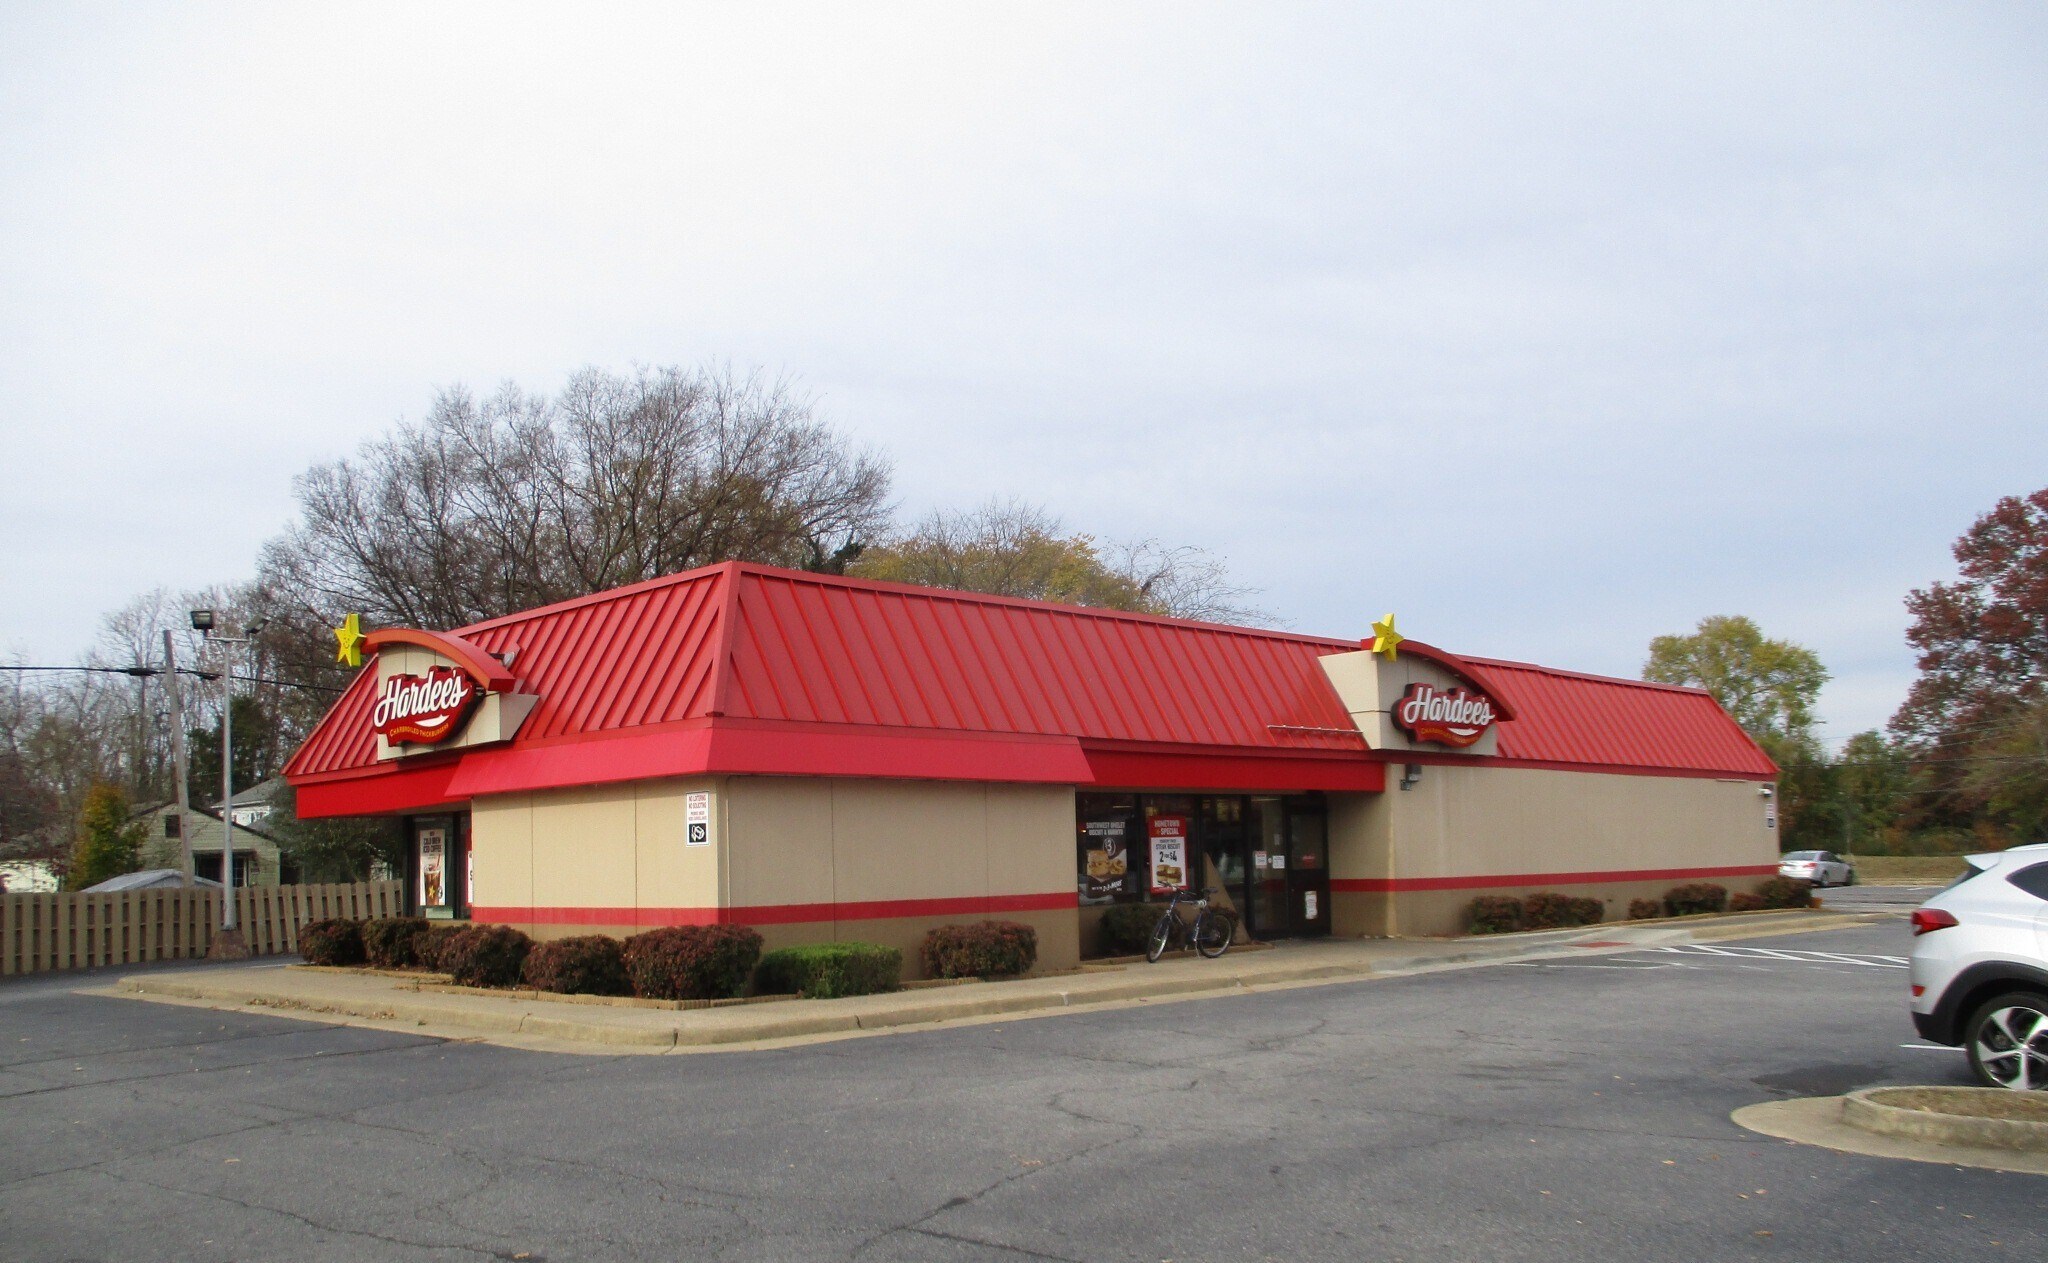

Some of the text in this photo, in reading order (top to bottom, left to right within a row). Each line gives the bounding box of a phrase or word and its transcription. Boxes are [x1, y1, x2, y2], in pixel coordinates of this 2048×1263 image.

[374, 670, 469, 727] Hardee's
[1404, 687, 1496, 726] Hardee's
[1160, 851, 1164, 862] 2
